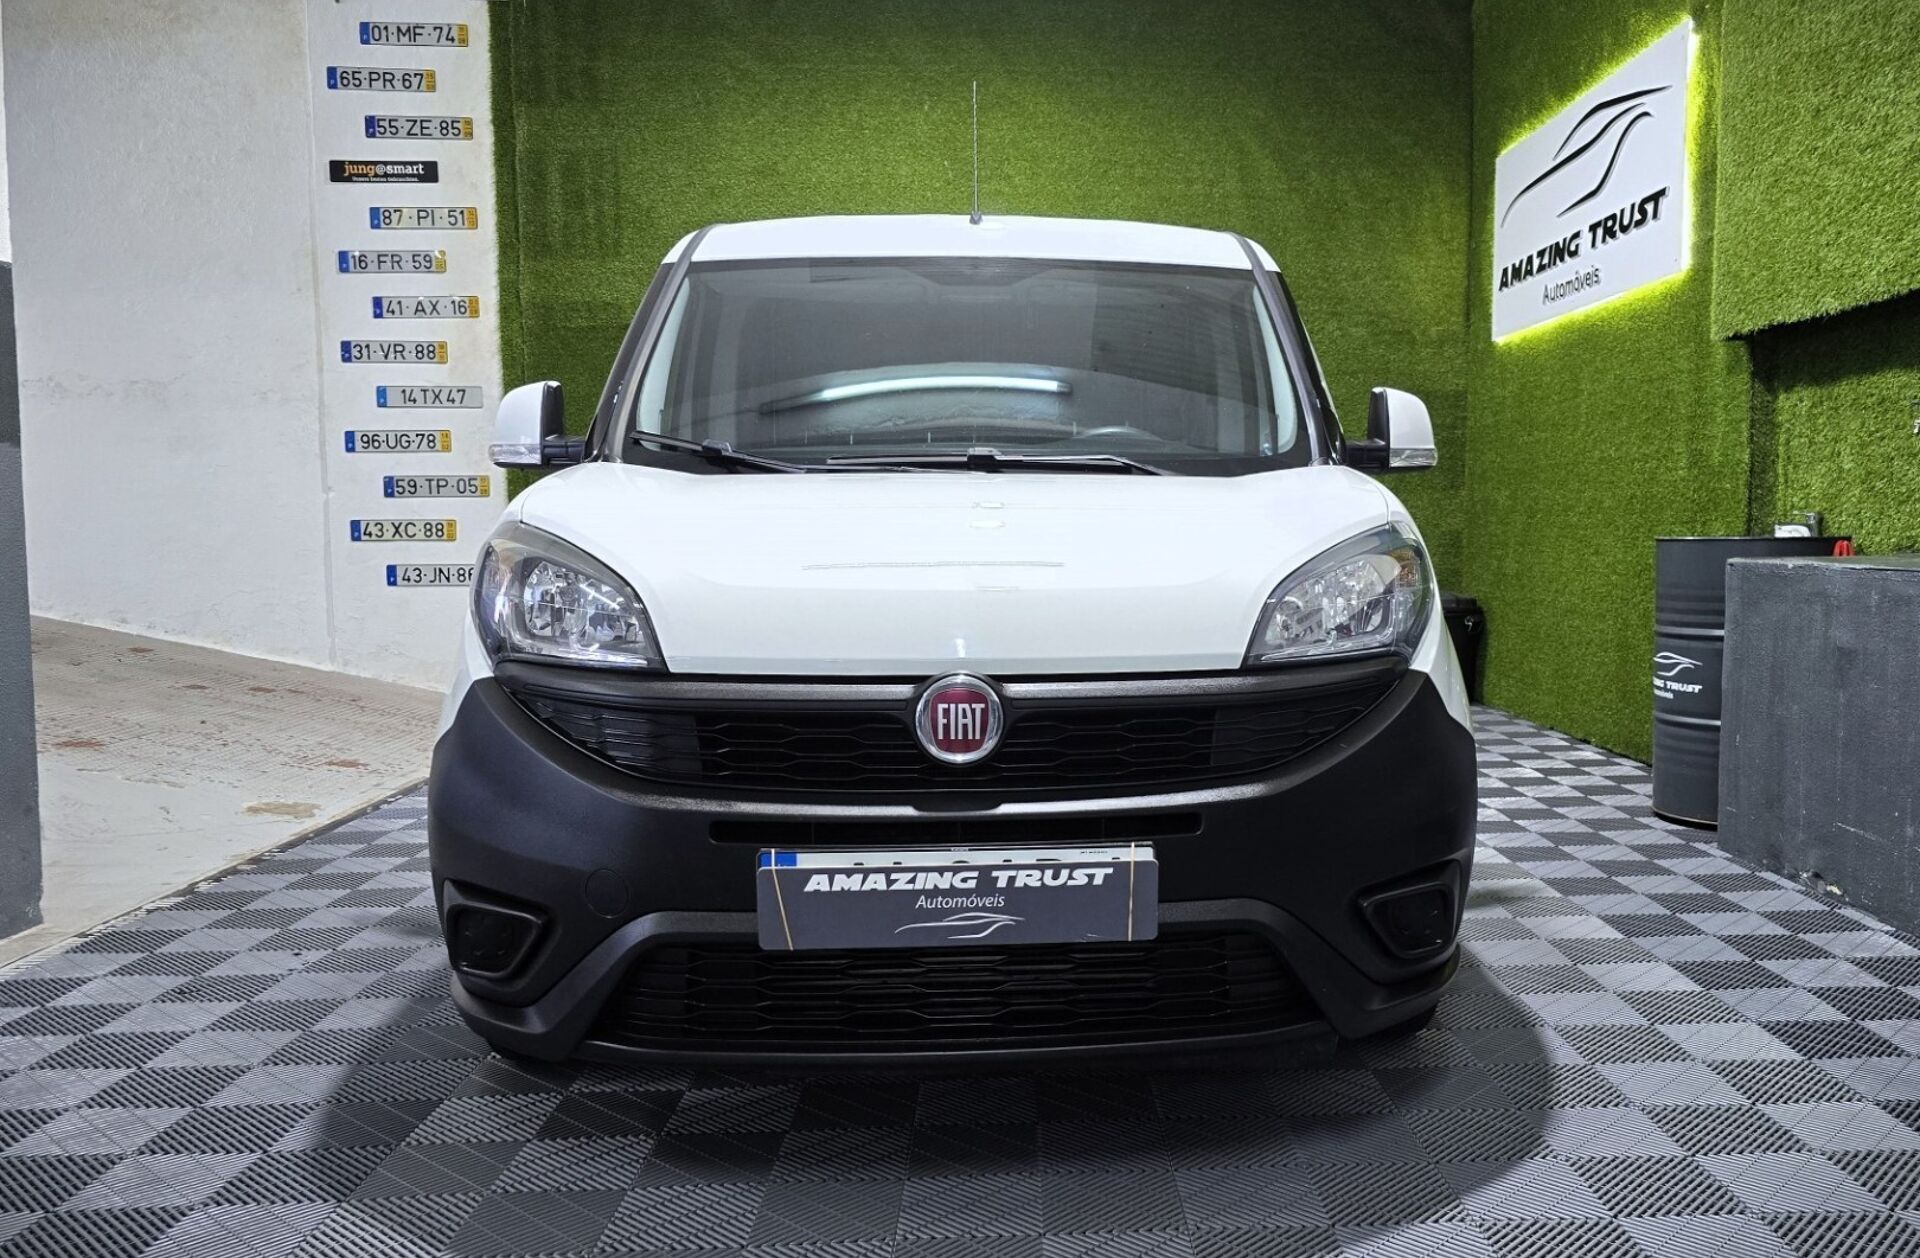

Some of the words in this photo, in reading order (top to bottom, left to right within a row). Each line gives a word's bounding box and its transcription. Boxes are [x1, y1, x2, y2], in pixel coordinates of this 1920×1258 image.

[343, 162, 424, 176] jung@smart
[1499, 229, 1583, 292] AMAZING
[1588, 186, 1670, 250] TRUST
[1542, 264, 1602, 305] Automóveis
[1665, 680, 1703, 694] TRUST
[937, 703, 985, 740] FIAT
[803, 871, 979, 892] AMAZING
[991, 867, 1113, 888] TRUST
[915, 893, 1005, 909] Automóveis
